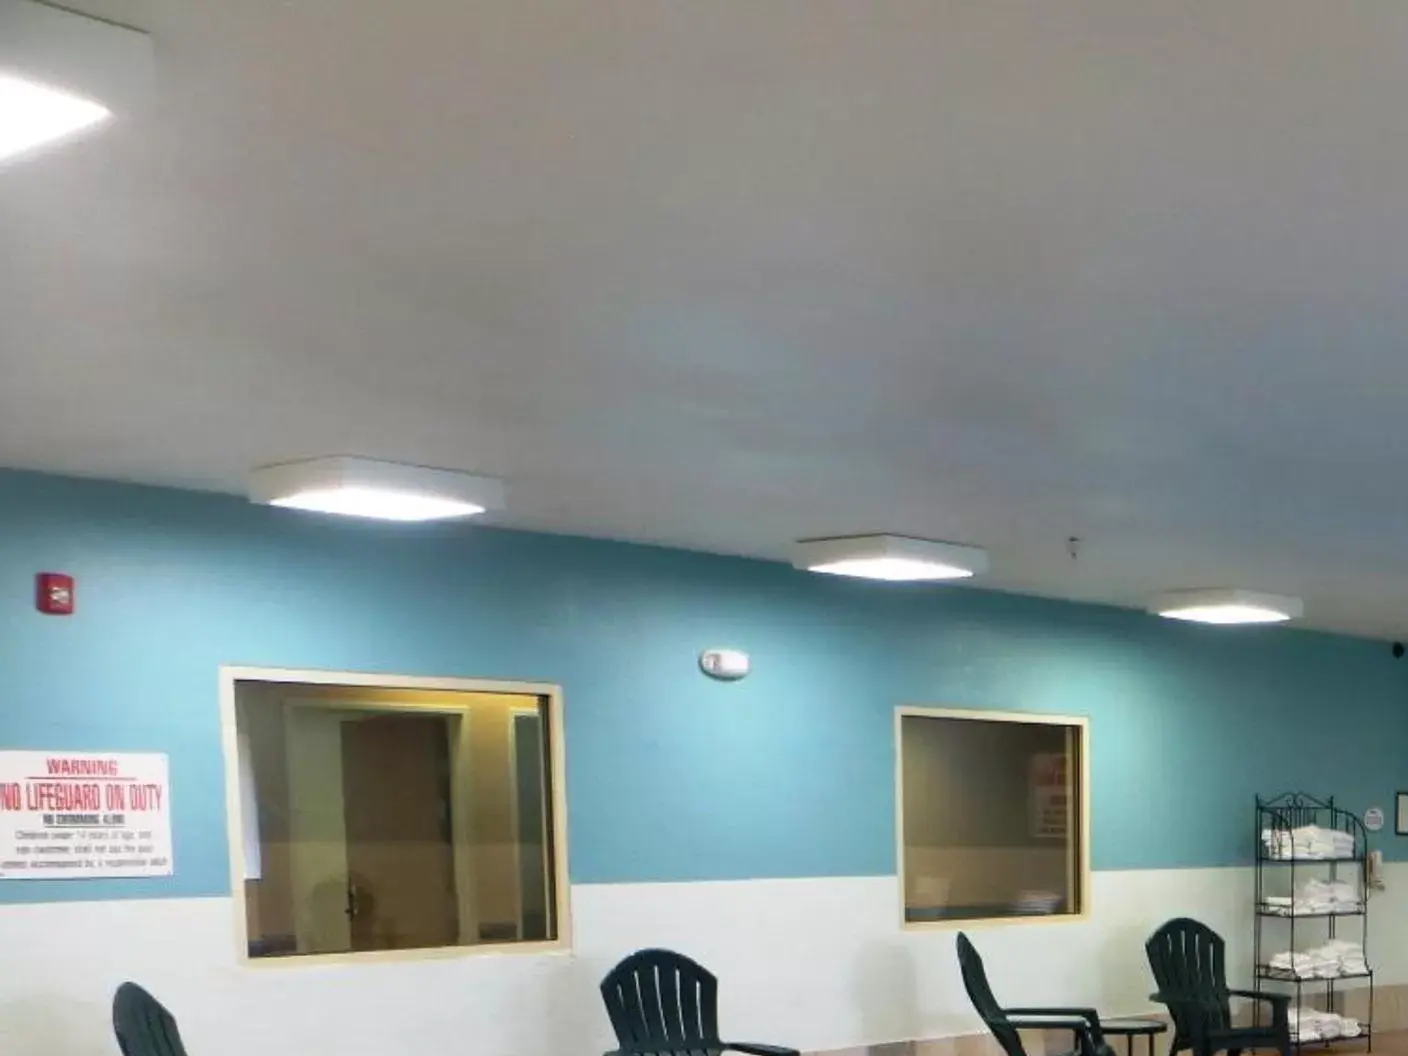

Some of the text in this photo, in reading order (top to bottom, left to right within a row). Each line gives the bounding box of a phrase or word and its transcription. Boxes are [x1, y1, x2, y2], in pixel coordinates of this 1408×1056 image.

[46, 758, 118, 776] WARNING
[0, 782, 161, 811] NO LIFEGUARD ON DUTY
